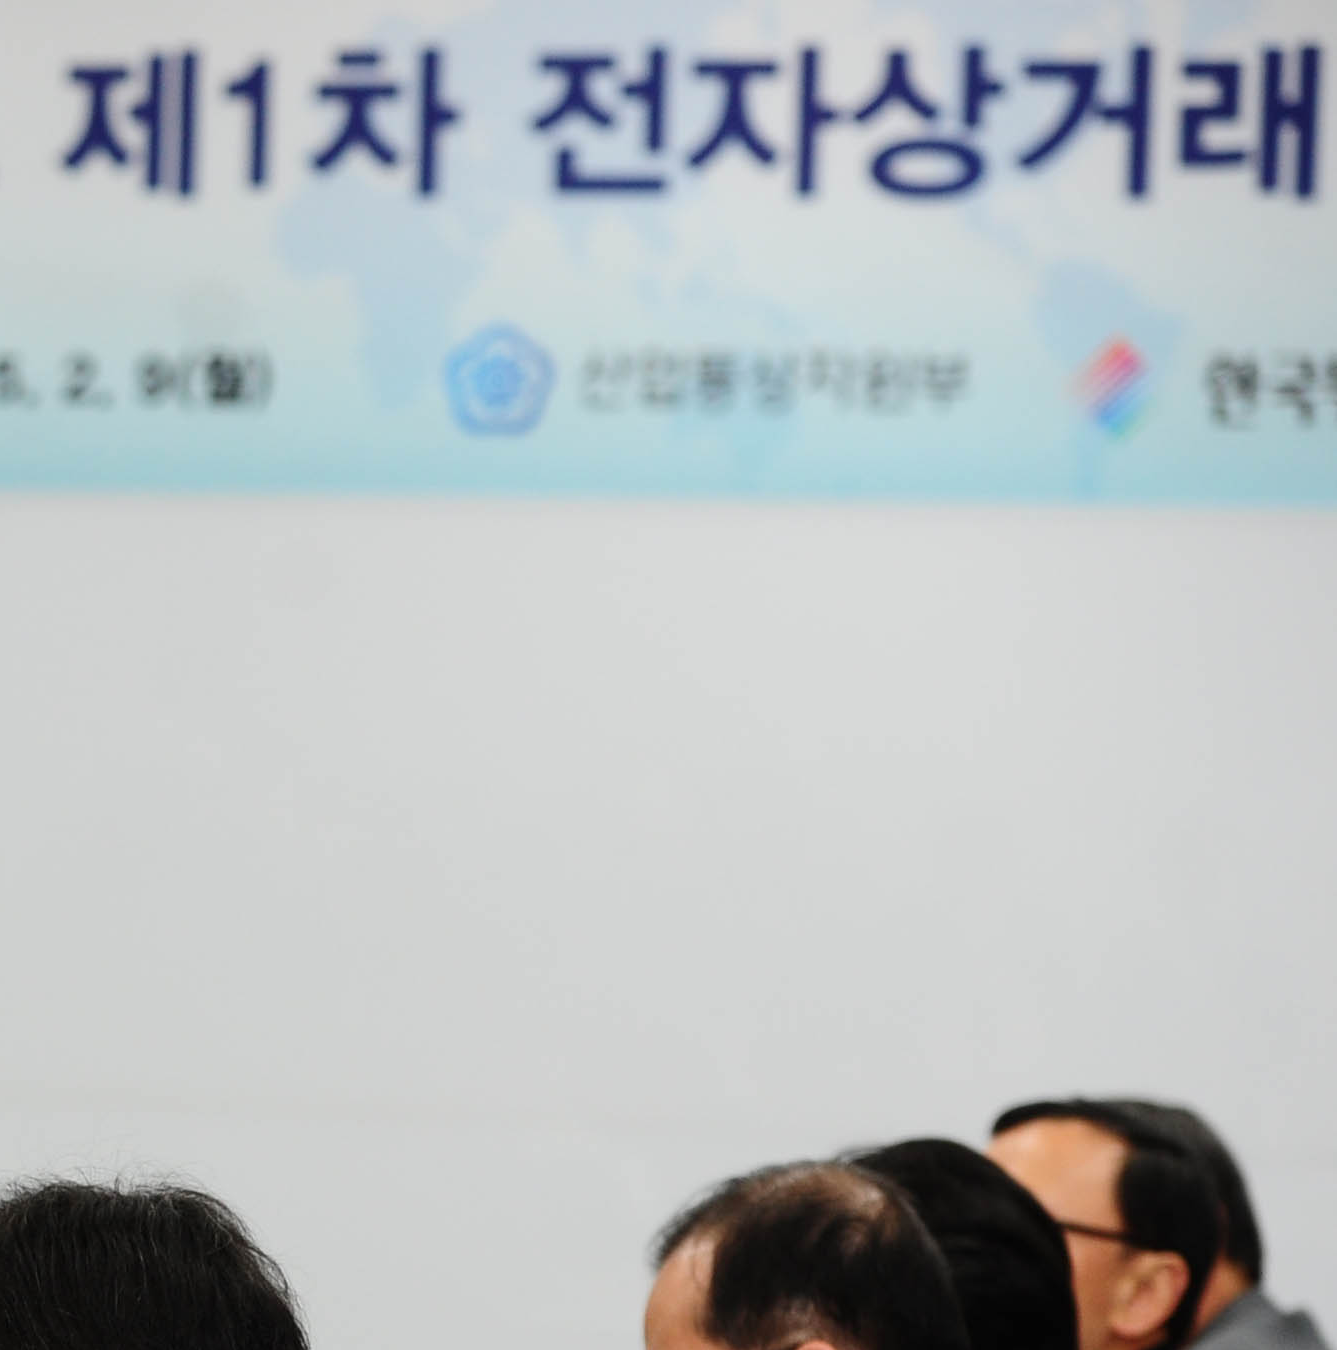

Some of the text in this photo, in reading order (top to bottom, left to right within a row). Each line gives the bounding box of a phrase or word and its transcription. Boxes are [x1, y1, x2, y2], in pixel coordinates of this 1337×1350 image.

[62, 47, 460, 198] 제1차
[532, 43, 1323, 201] 전자상거래
[1205, 354, 1337, 427] 한국
